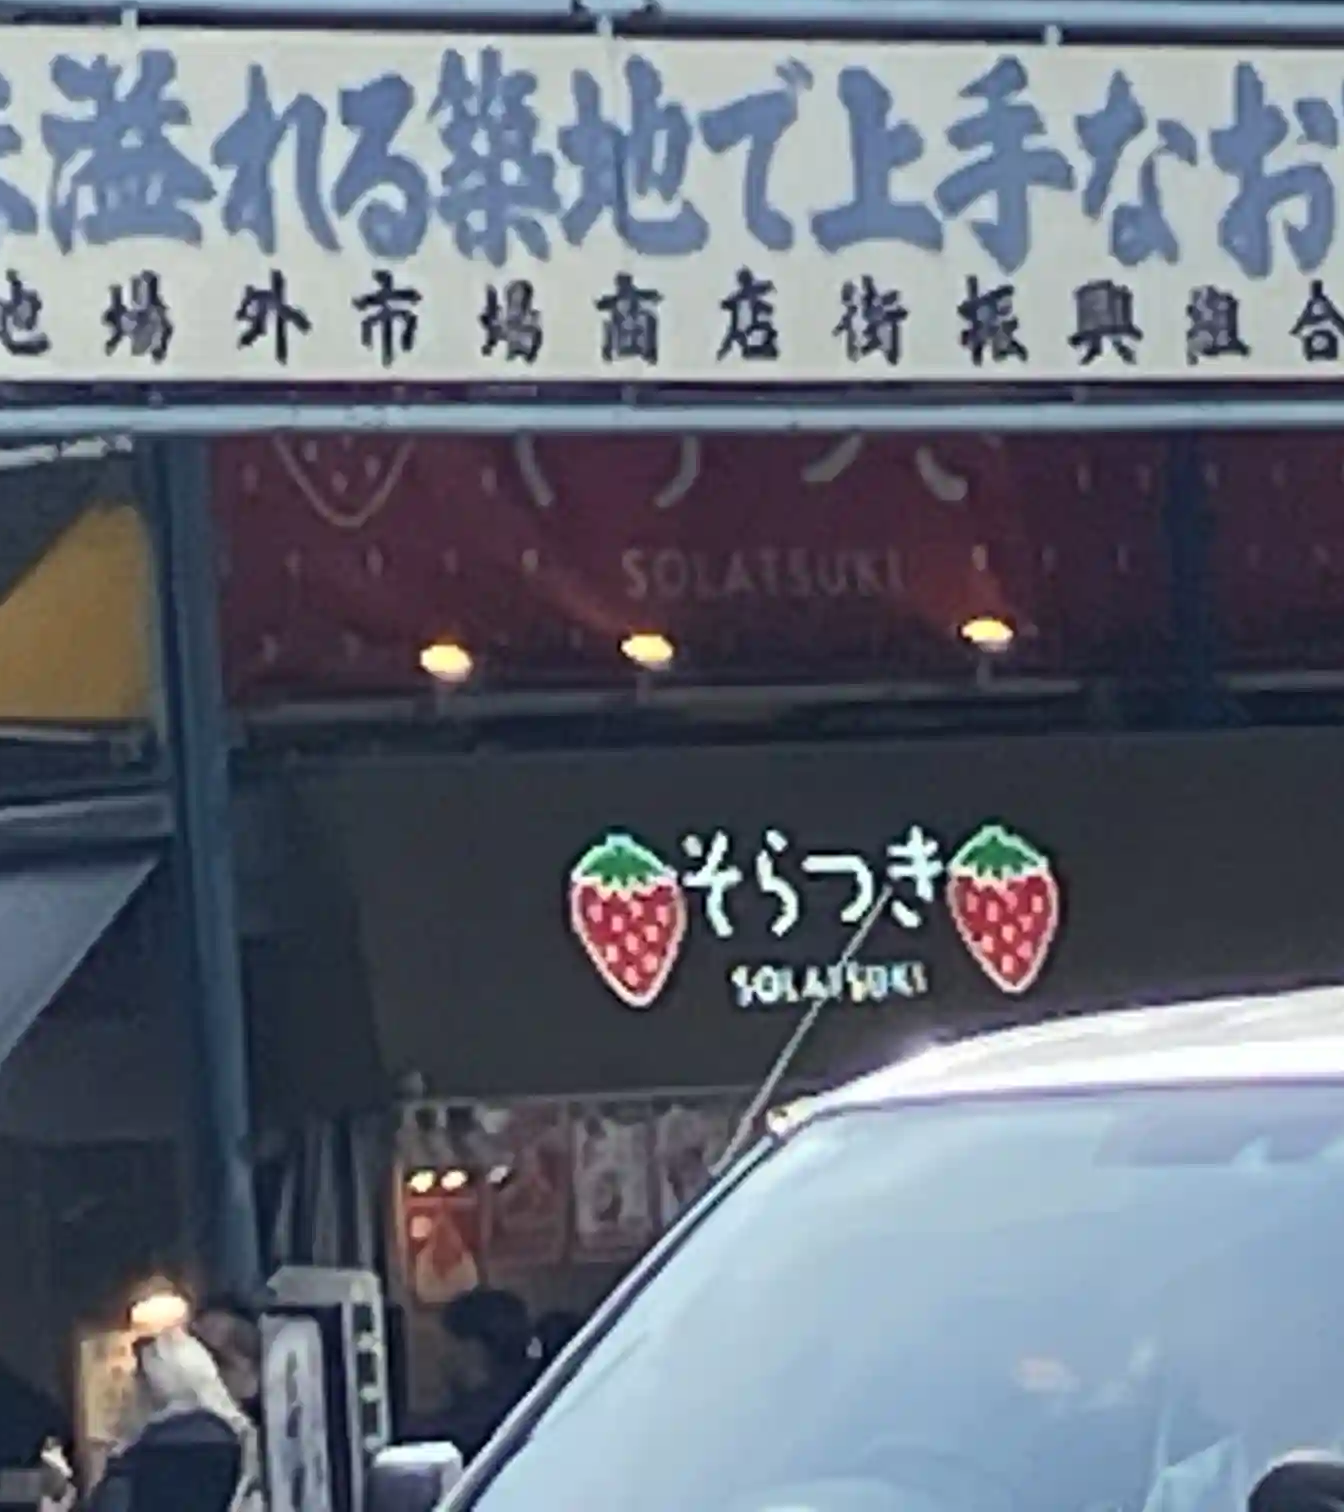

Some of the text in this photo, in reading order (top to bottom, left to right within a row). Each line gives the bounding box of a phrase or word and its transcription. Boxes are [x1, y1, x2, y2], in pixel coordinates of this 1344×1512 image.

[621, 546, 906, 599] SOLATSUKI
[680, 824, 946, 938] そらつき
[730, 958, 929, 1008] SOLATSUKI
